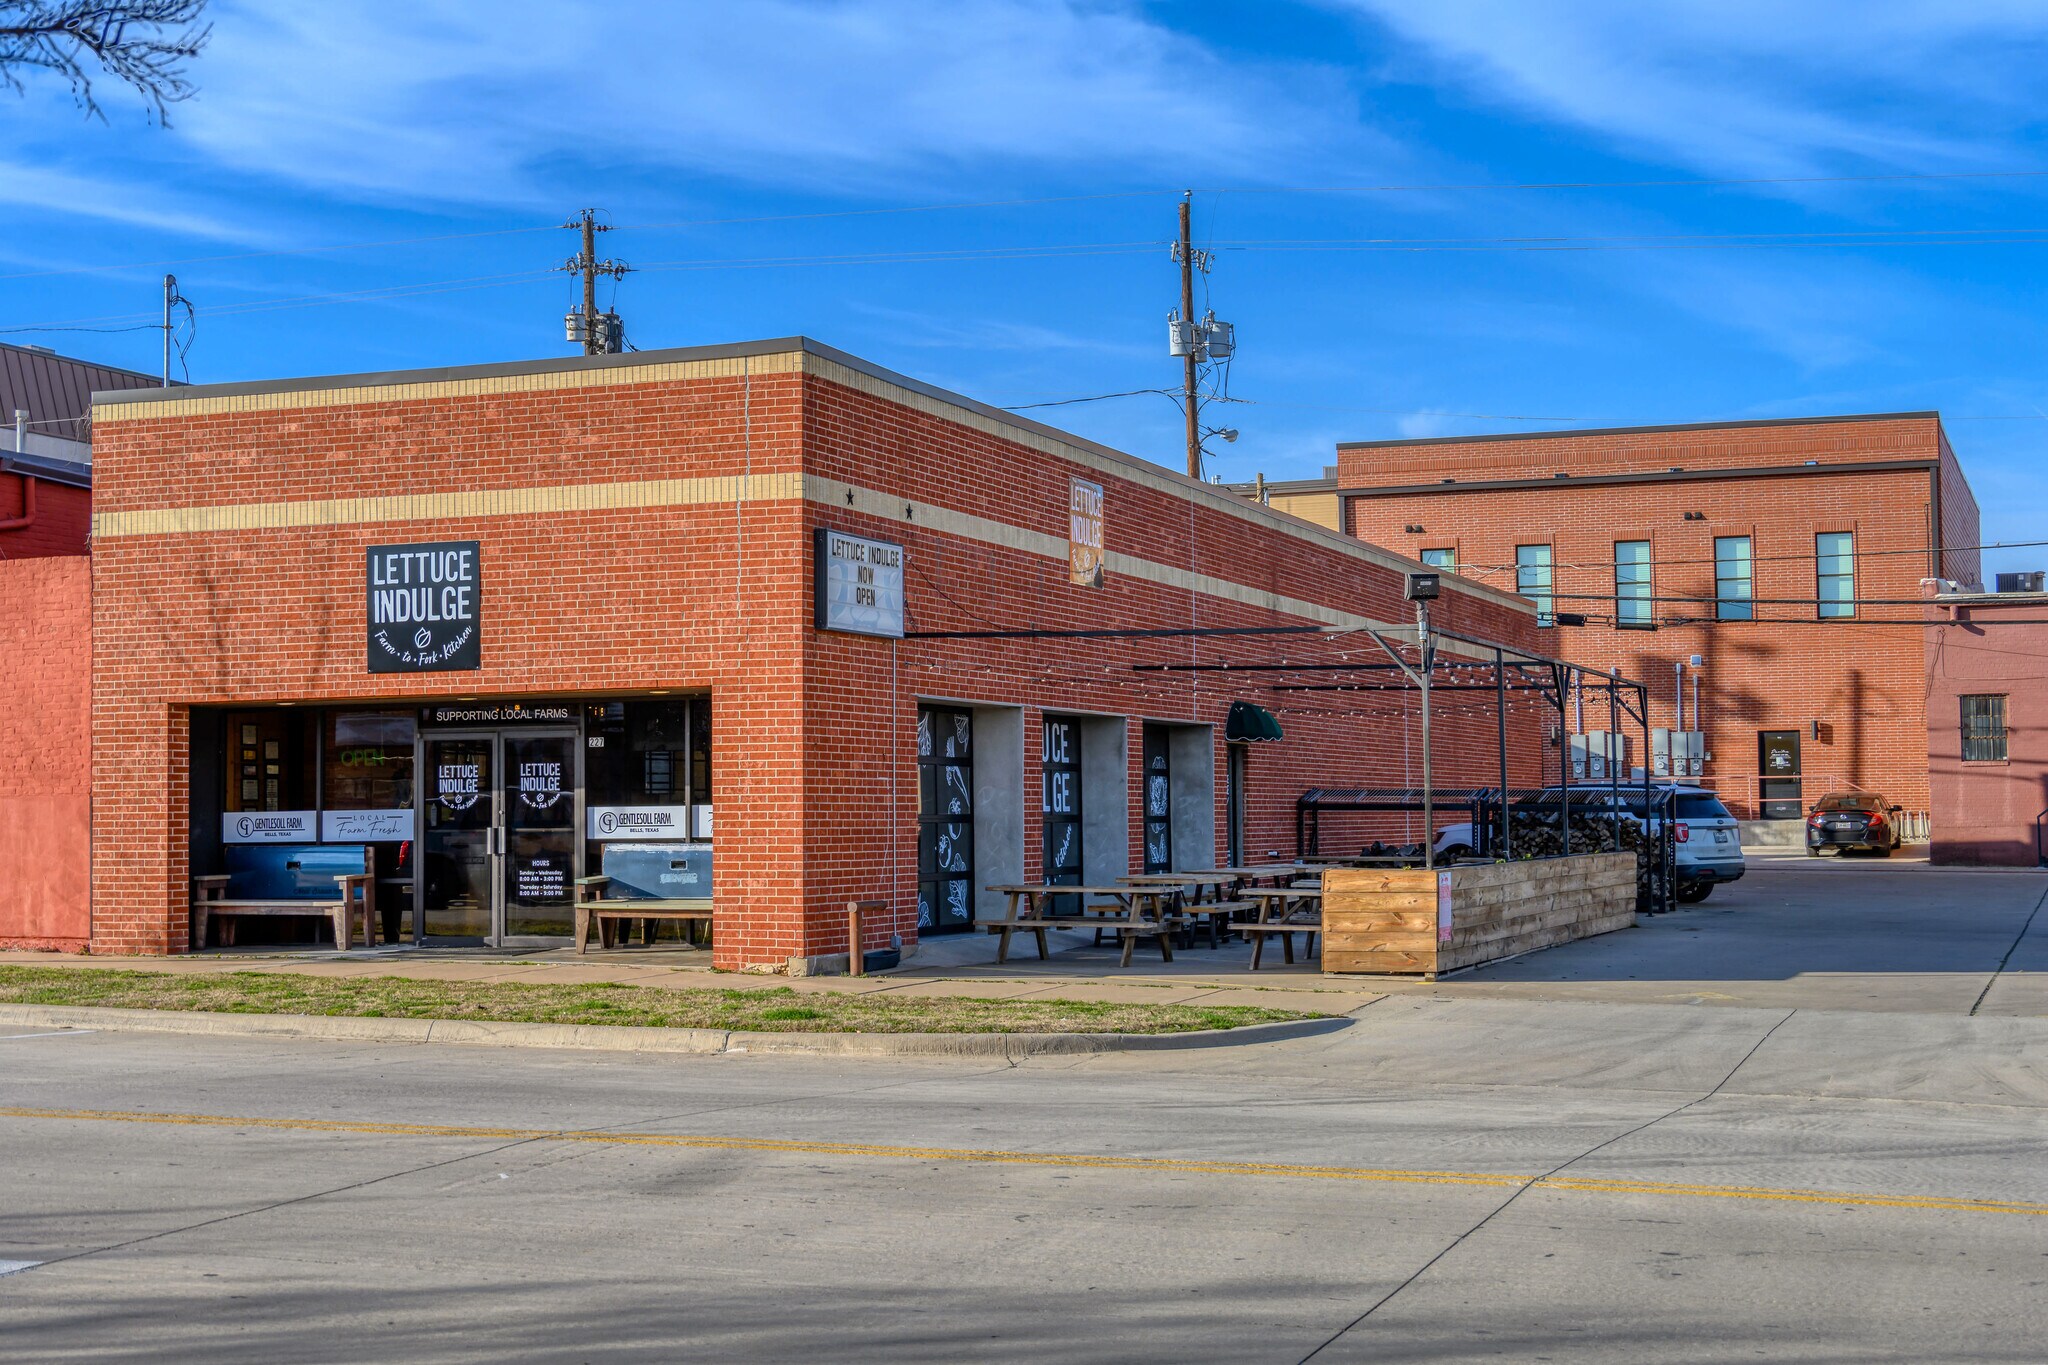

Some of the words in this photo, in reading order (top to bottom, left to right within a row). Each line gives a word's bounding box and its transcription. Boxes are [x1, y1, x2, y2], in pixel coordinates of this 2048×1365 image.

[1070, 484, 1102, 518] LETTUCE
[1070, 514, 1102, 548] INDULGE
[832, 538, 865, 562] LETTUCE
[868, 546, 900, 568] INDULGE
[373, 550, 472, 586] LETTUCE
[858, 566, 874, 584] NOW
[373, 586, 472, 624] INDULGE
[856, 587, 876, 606] OPEN
[374, 629, 396, 656] Farm
[402, 650, 412, 663] to
[418, 651, 438, 666] Fork
[443, 625, 472, 660] Kitchen
[436, 710, 498, 722] SUPPORTING
[500, 709, 532, 720] LOCAL
[534, 708, 568, 719] FARMS
[589, 737, 604, 747] 227
[343, 750, 384, 766] OPEN
[439, 764, 479, 778] LETTUCE
[520, 763, 561, 776] LETTUCE
[439, 778, 478, 793] INDULGE
[520, 777, 561, 792] INDULGE
[286, 817, 303, 829] FARM
[654, 812, 672, 824] FARM
[336, 822, 368, 838] Farm
[368, 820, 402, 838] Fresh
[1054, 824, 1072, 868] Kitchen
